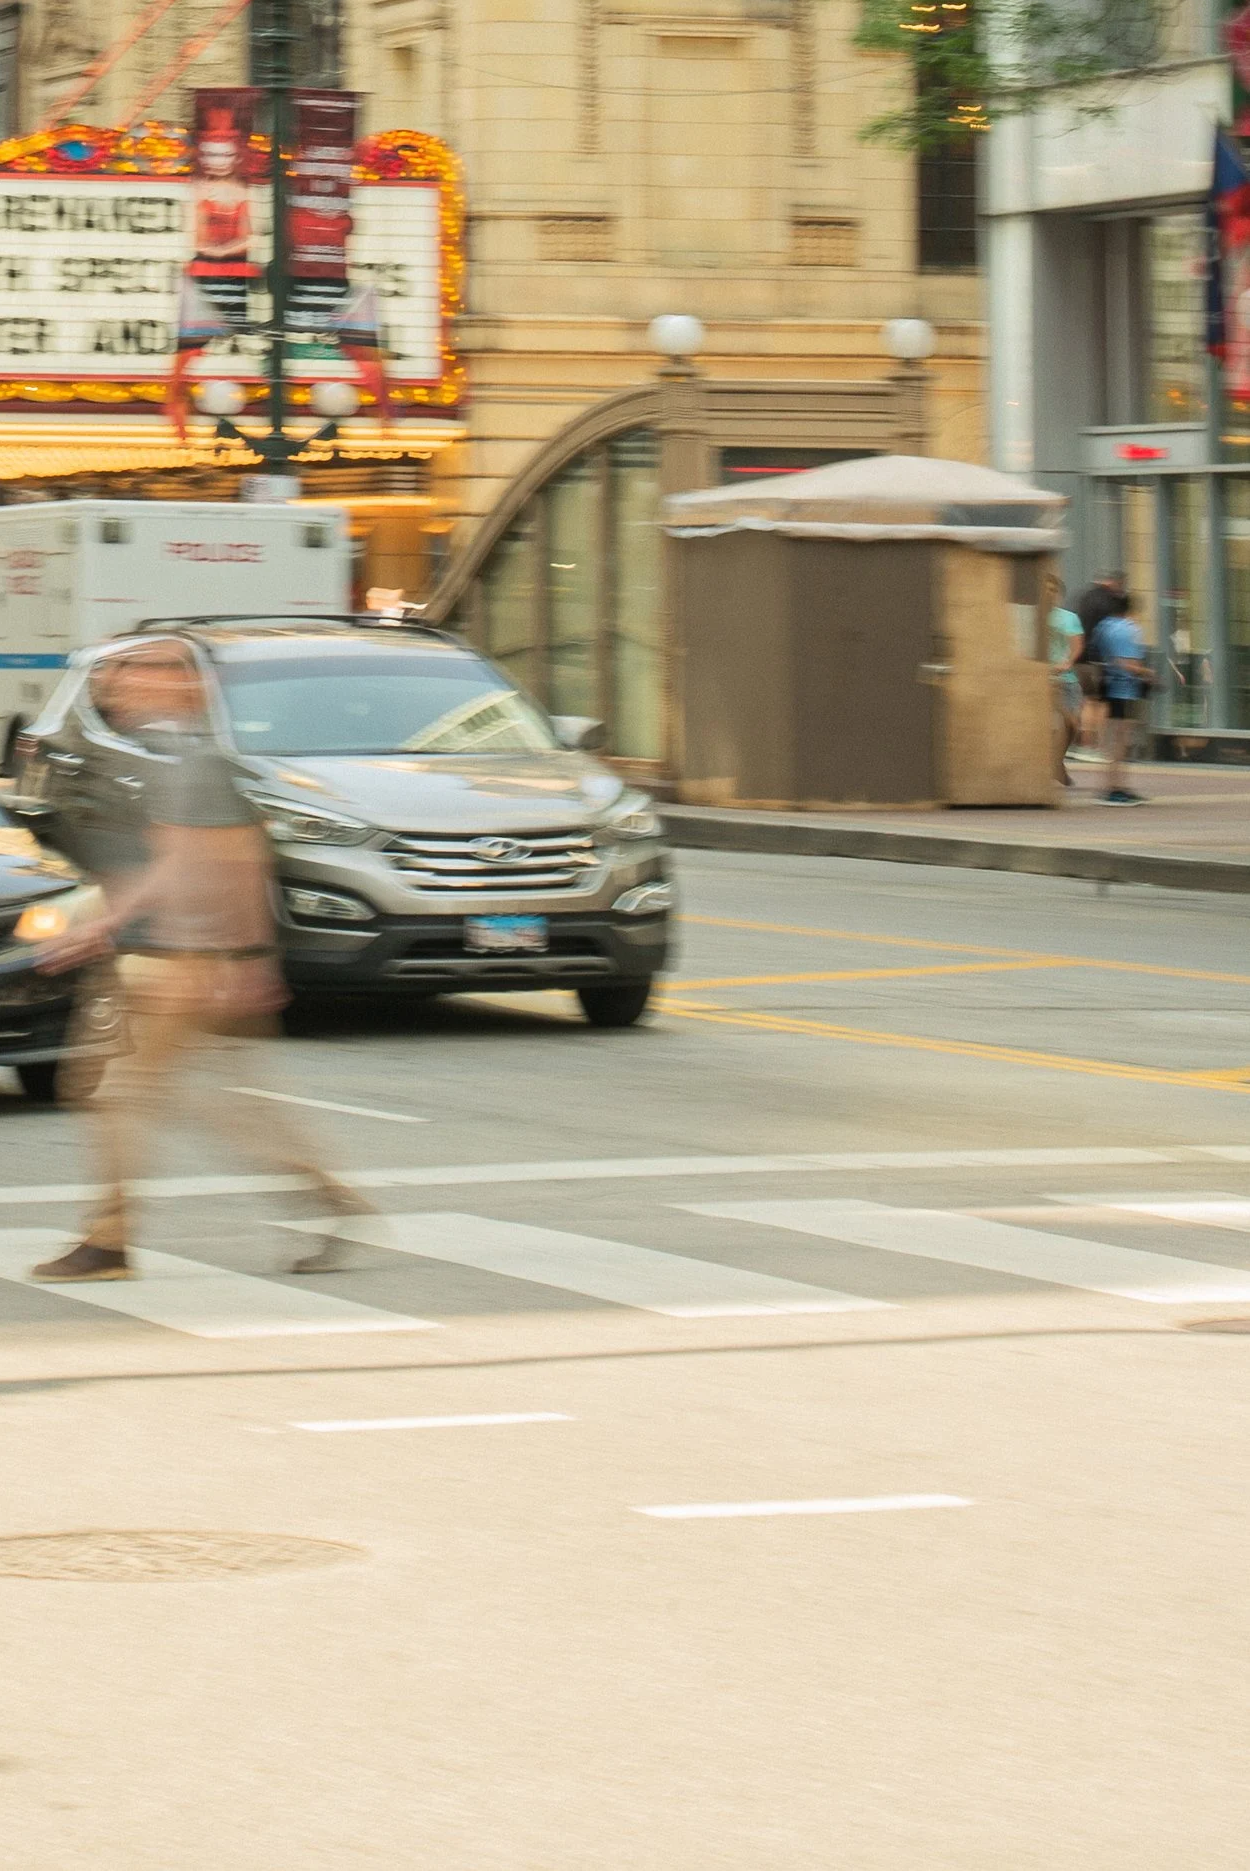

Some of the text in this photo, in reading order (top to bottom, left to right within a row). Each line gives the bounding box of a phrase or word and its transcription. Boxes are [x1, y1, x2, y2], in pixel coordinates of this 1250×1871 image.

[58, 257, 184, 294] SPECI
[93, 320, 179, 355] AND
[163, 541, 266, 563] POLICE
